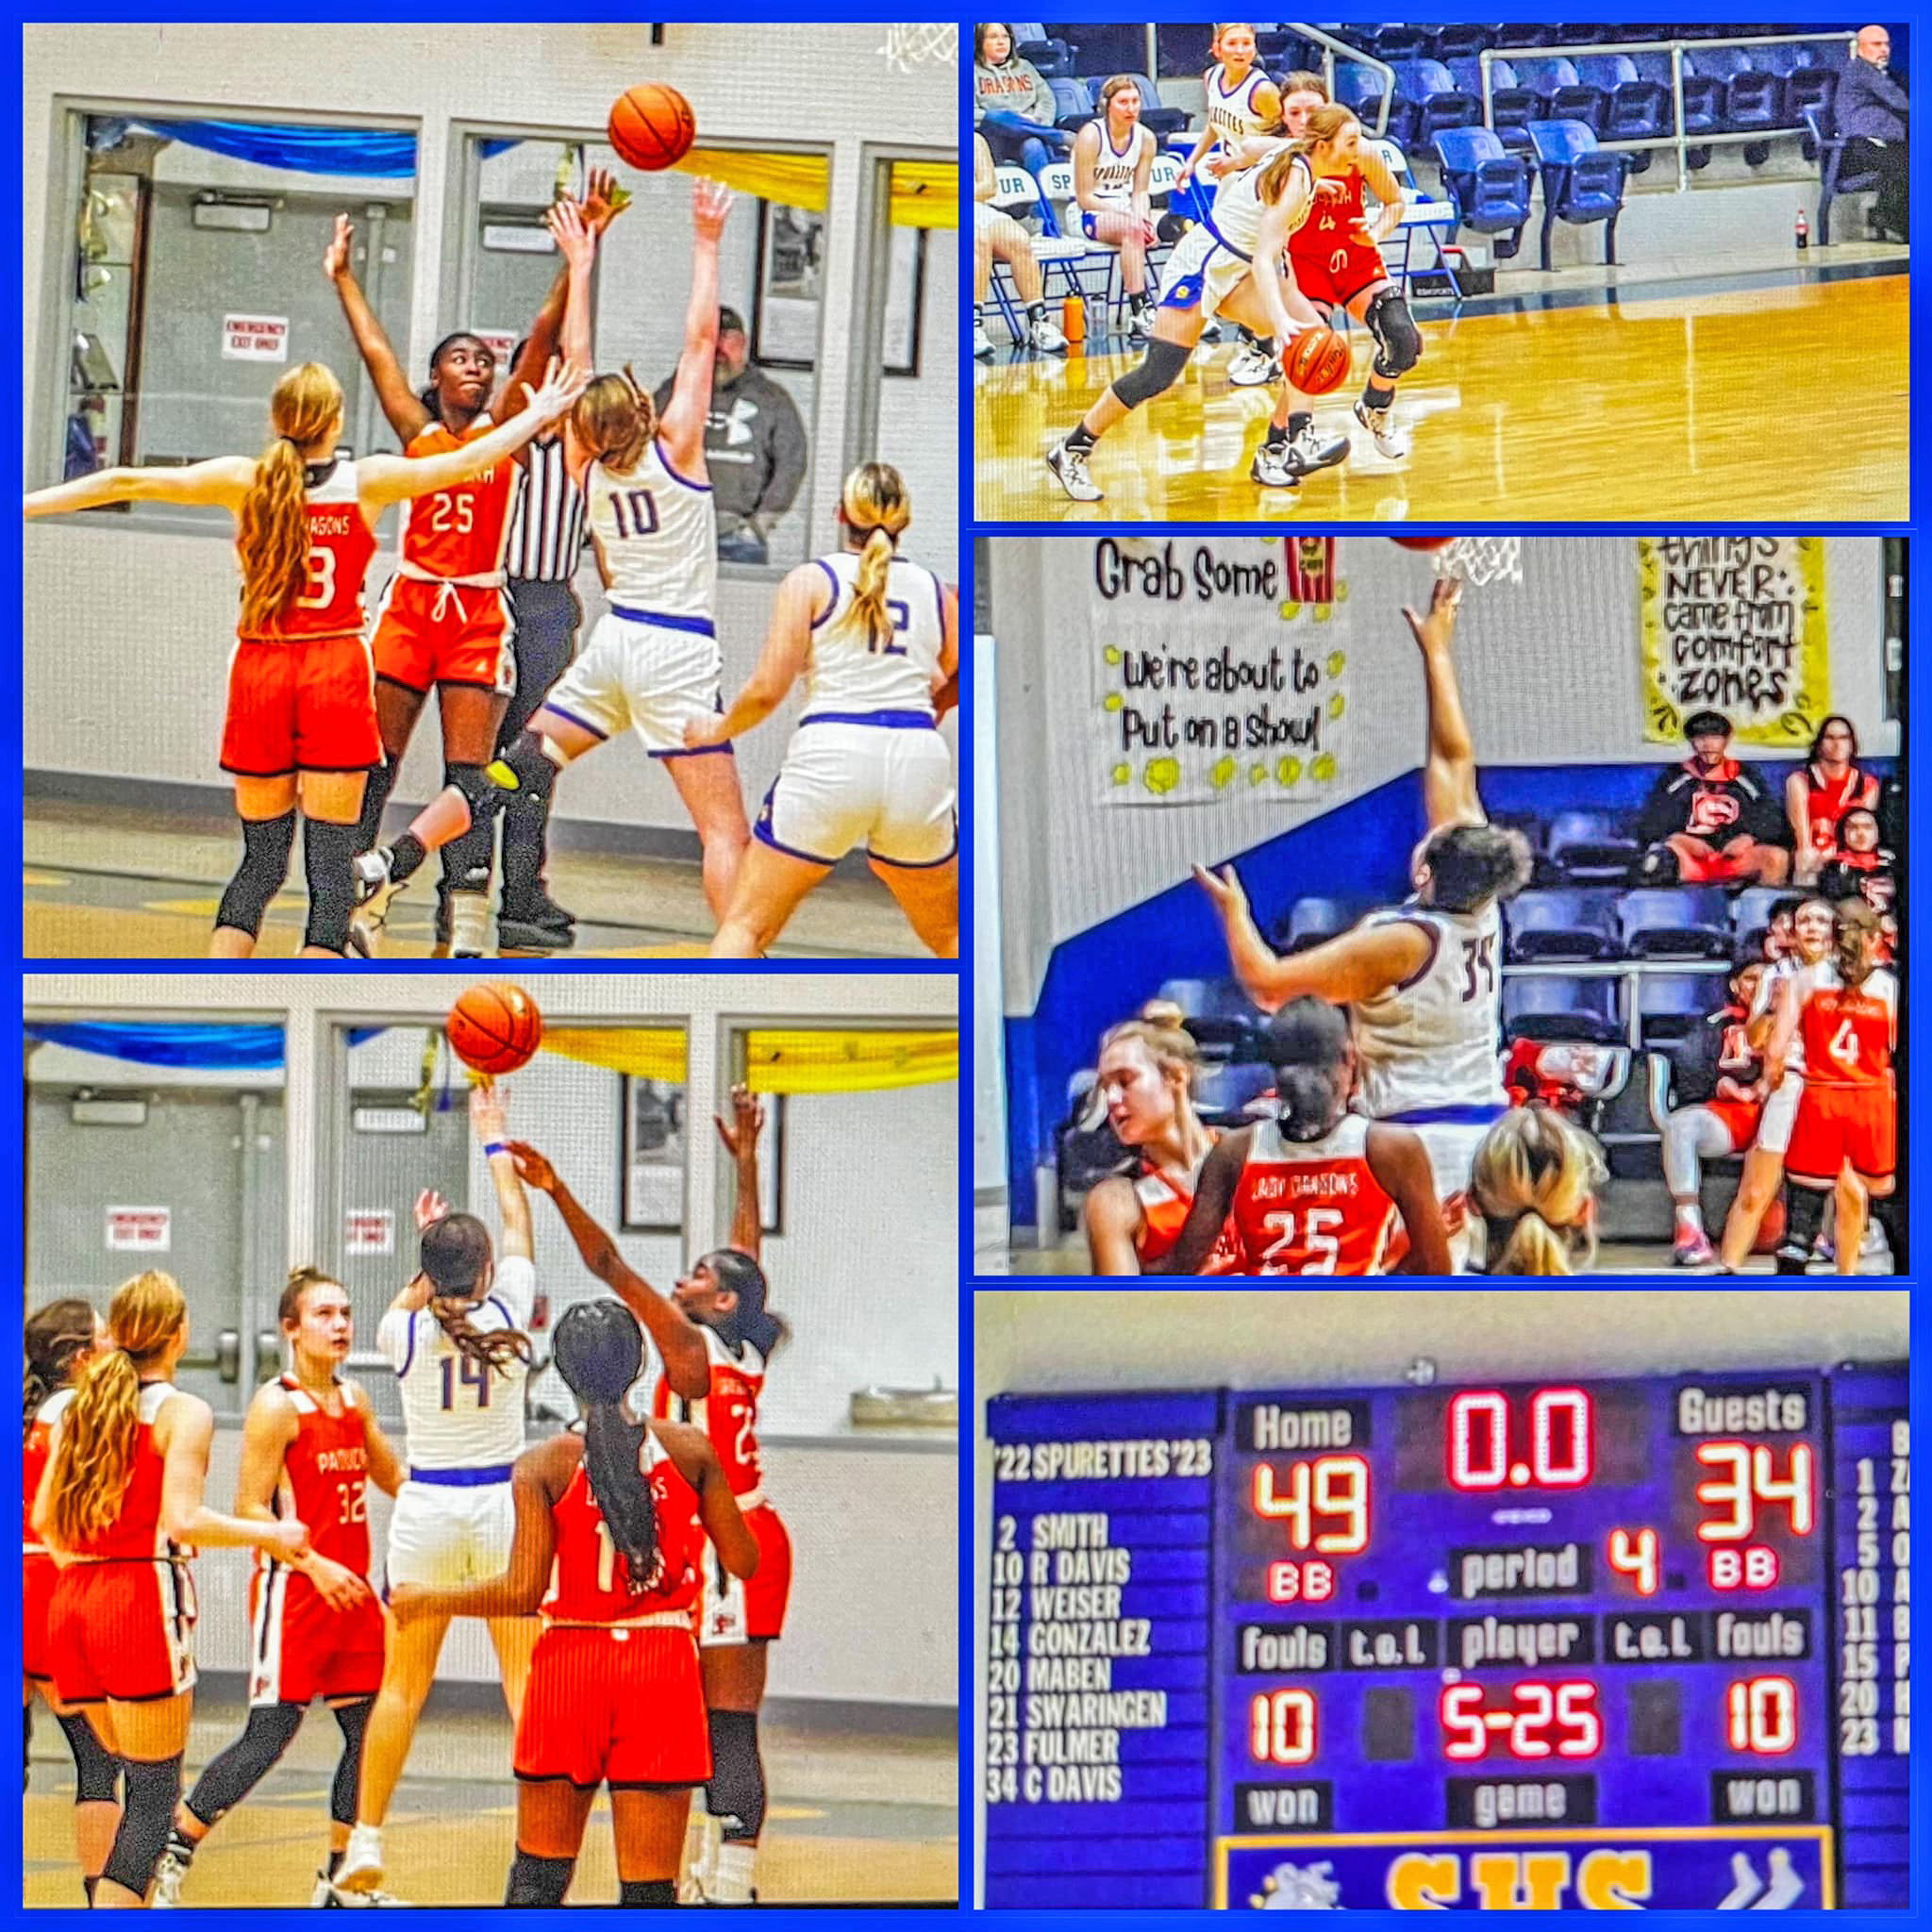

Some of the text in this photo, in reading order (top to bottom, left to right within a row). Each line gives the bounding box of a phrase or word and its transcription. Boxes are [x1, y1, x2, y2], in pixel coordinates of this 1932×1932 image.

[1000, 177, 1025, 194] UR
[1052, 174, 1071, 190] SP
[1152, 166, 1175, 184] UR
[431, 492, 475, 534] 25
[609, 489, 659, 540] 10
[1096, 537, 1184, 601] Grab
[1193, 545, 1279, 601] Some
[1664, 601, 1729, 632] came
[1205, 645, 1284, 693] about
[1292, 647, 1319, 693] to
[1674, 629, 1800, 668] comfort
[1680, 666, 1789, 712] zones
[1122, 703, 1179, 752] Put
[1186, 714, 1219, 748] on
[1225, 714, 1241, 748] a
[1830, 1017, 1859, 1065] 4
[1260, 1208, 1343, 1274] 25
[441, 1355, 489, 1410] 14
[1254, 1405, 1353, 1450] Home
[1678, 1388, 1807, 1435] Guests
[1032, 1440, 1170, 1480] SPURETTES
[1171, 1438, 1213, 1477] '23
[1448, 1390, 1594, 1491] 0.0
[1698, 1441, 1815, 1542] 34
[1857, 1458, 1875, 1494] 1
[337, 1482, 365, 1524] 32
[1254, 1454, 1371, 1557] 49
[1857, 1495, 1879, 1531] 2
[999, 1512, 1108, 1551] 2 SMITH
[1857, 1531, 1880, 1568] 5
[993, 1547, 1131, 1588] 10 R DAVIS
[1461, 1542, 1579, 1599] period
[1608, 1527, 1658, 1596] 4
[992, 1585, 1122, 1623] 12 WEISER
[1842, 1567, 1880, 1605] 10
[991, 1619, 1151, 1657] 14 GONZALEZ
[1462, 1615, 1580, 1669] player
[1716, 1611, 1805, 1657] fouls
[1843, 1606, 1879, 1642] 11
[1242, 1624, 1328, 1671] fouls
[1842, 1642, 1880, 1679] 15
[989, 1657, 1111, 1693] 20 MABEN
[989, 1690, 1167, 1729] 21 SWARINGEN
[1727, 1674, 1798, 1756] 10
[1840, 1679, 1880, 1718] 20
[1251, 1688, 1319, 1767] 10
[1441, 1679, 1603, 1762] 5-25
[1840, 1717, 1880, 1757] 23
[988, 1729, 1120, 1766] 23 FULMER
[987, 1764, 1122, 1803] 34 C DAVIS
[1727, 1778, 1801, 1817] won
[1247, 1789, 1320, 1826] won
[1474, 1782, 1567, 1828] game
[1386, 1849, 1652, 1909] SHS
